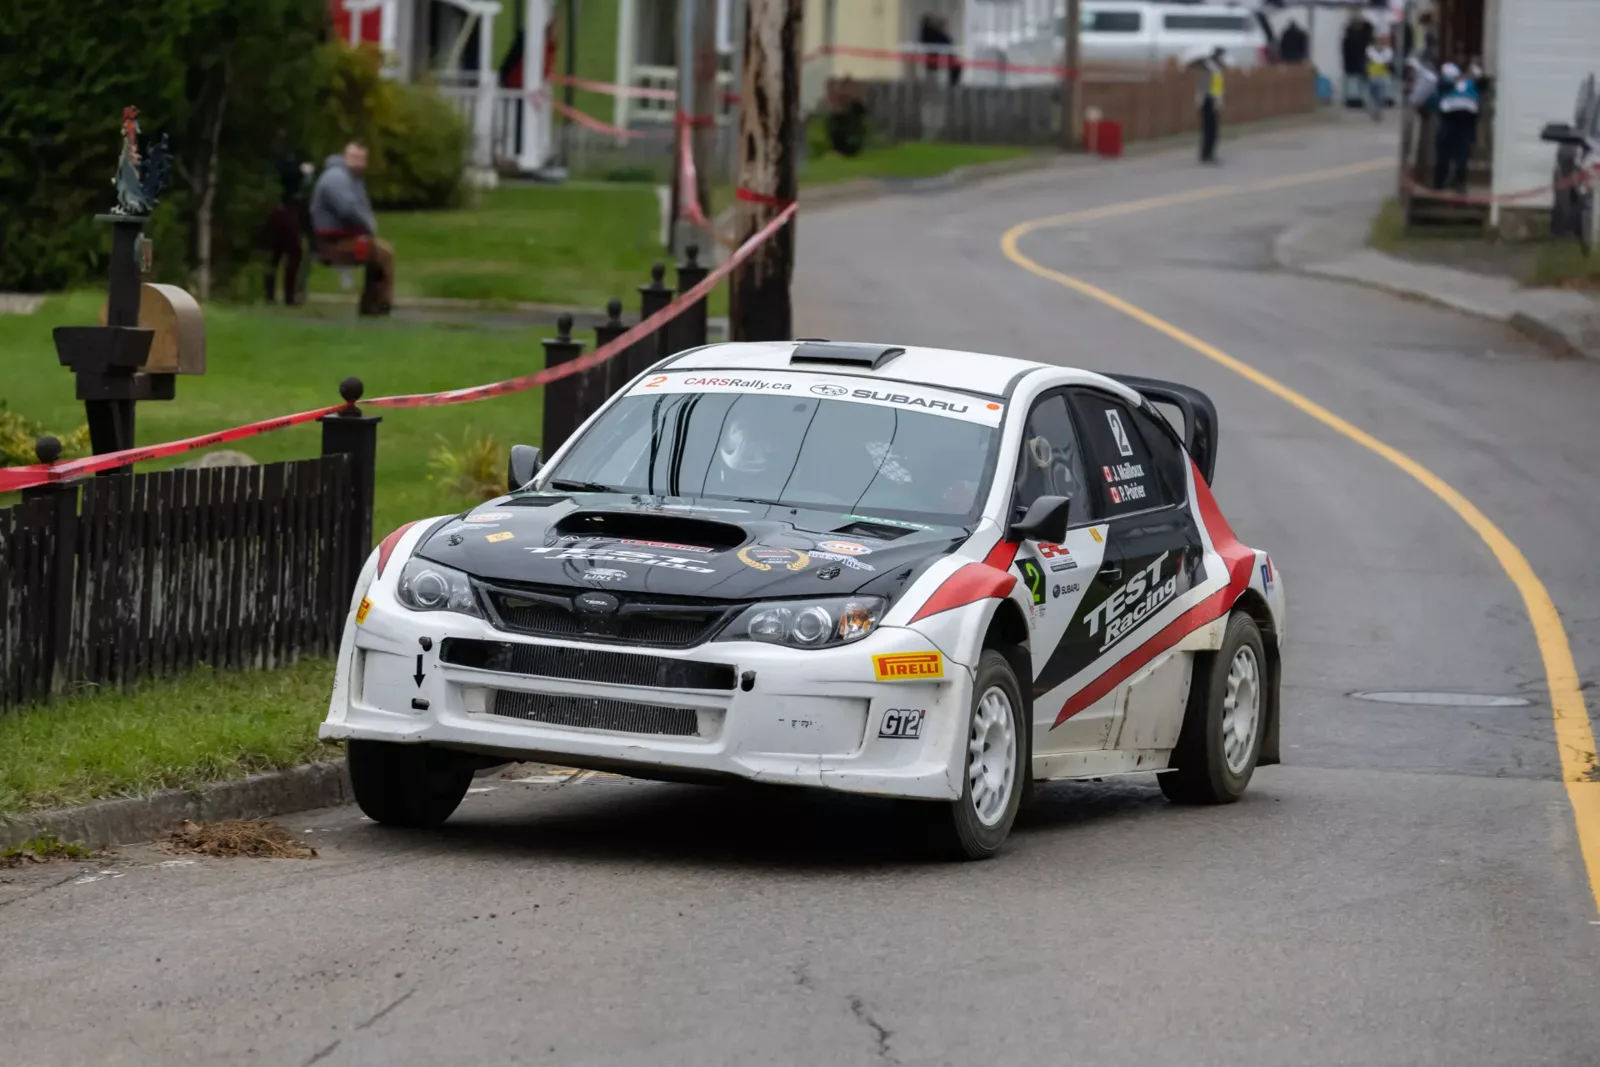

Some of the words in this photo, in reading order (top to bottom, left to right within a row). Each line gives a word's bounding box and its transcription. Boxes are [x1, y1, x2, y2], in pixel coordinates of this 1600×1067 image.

[644, 376, 668, 388] 2
[684, 377, 792, 390] CARSRally.ca
[851, 389, 969, 413] SUBARU
[1109, 413, 1130, 453] 2
[1025, 562, 1040, 602] 2
[1083, 550, 1169, 637] TEST
[1105, 574, 1177, 645] Racing
[877, 654, 939, 676] PIRELLI
